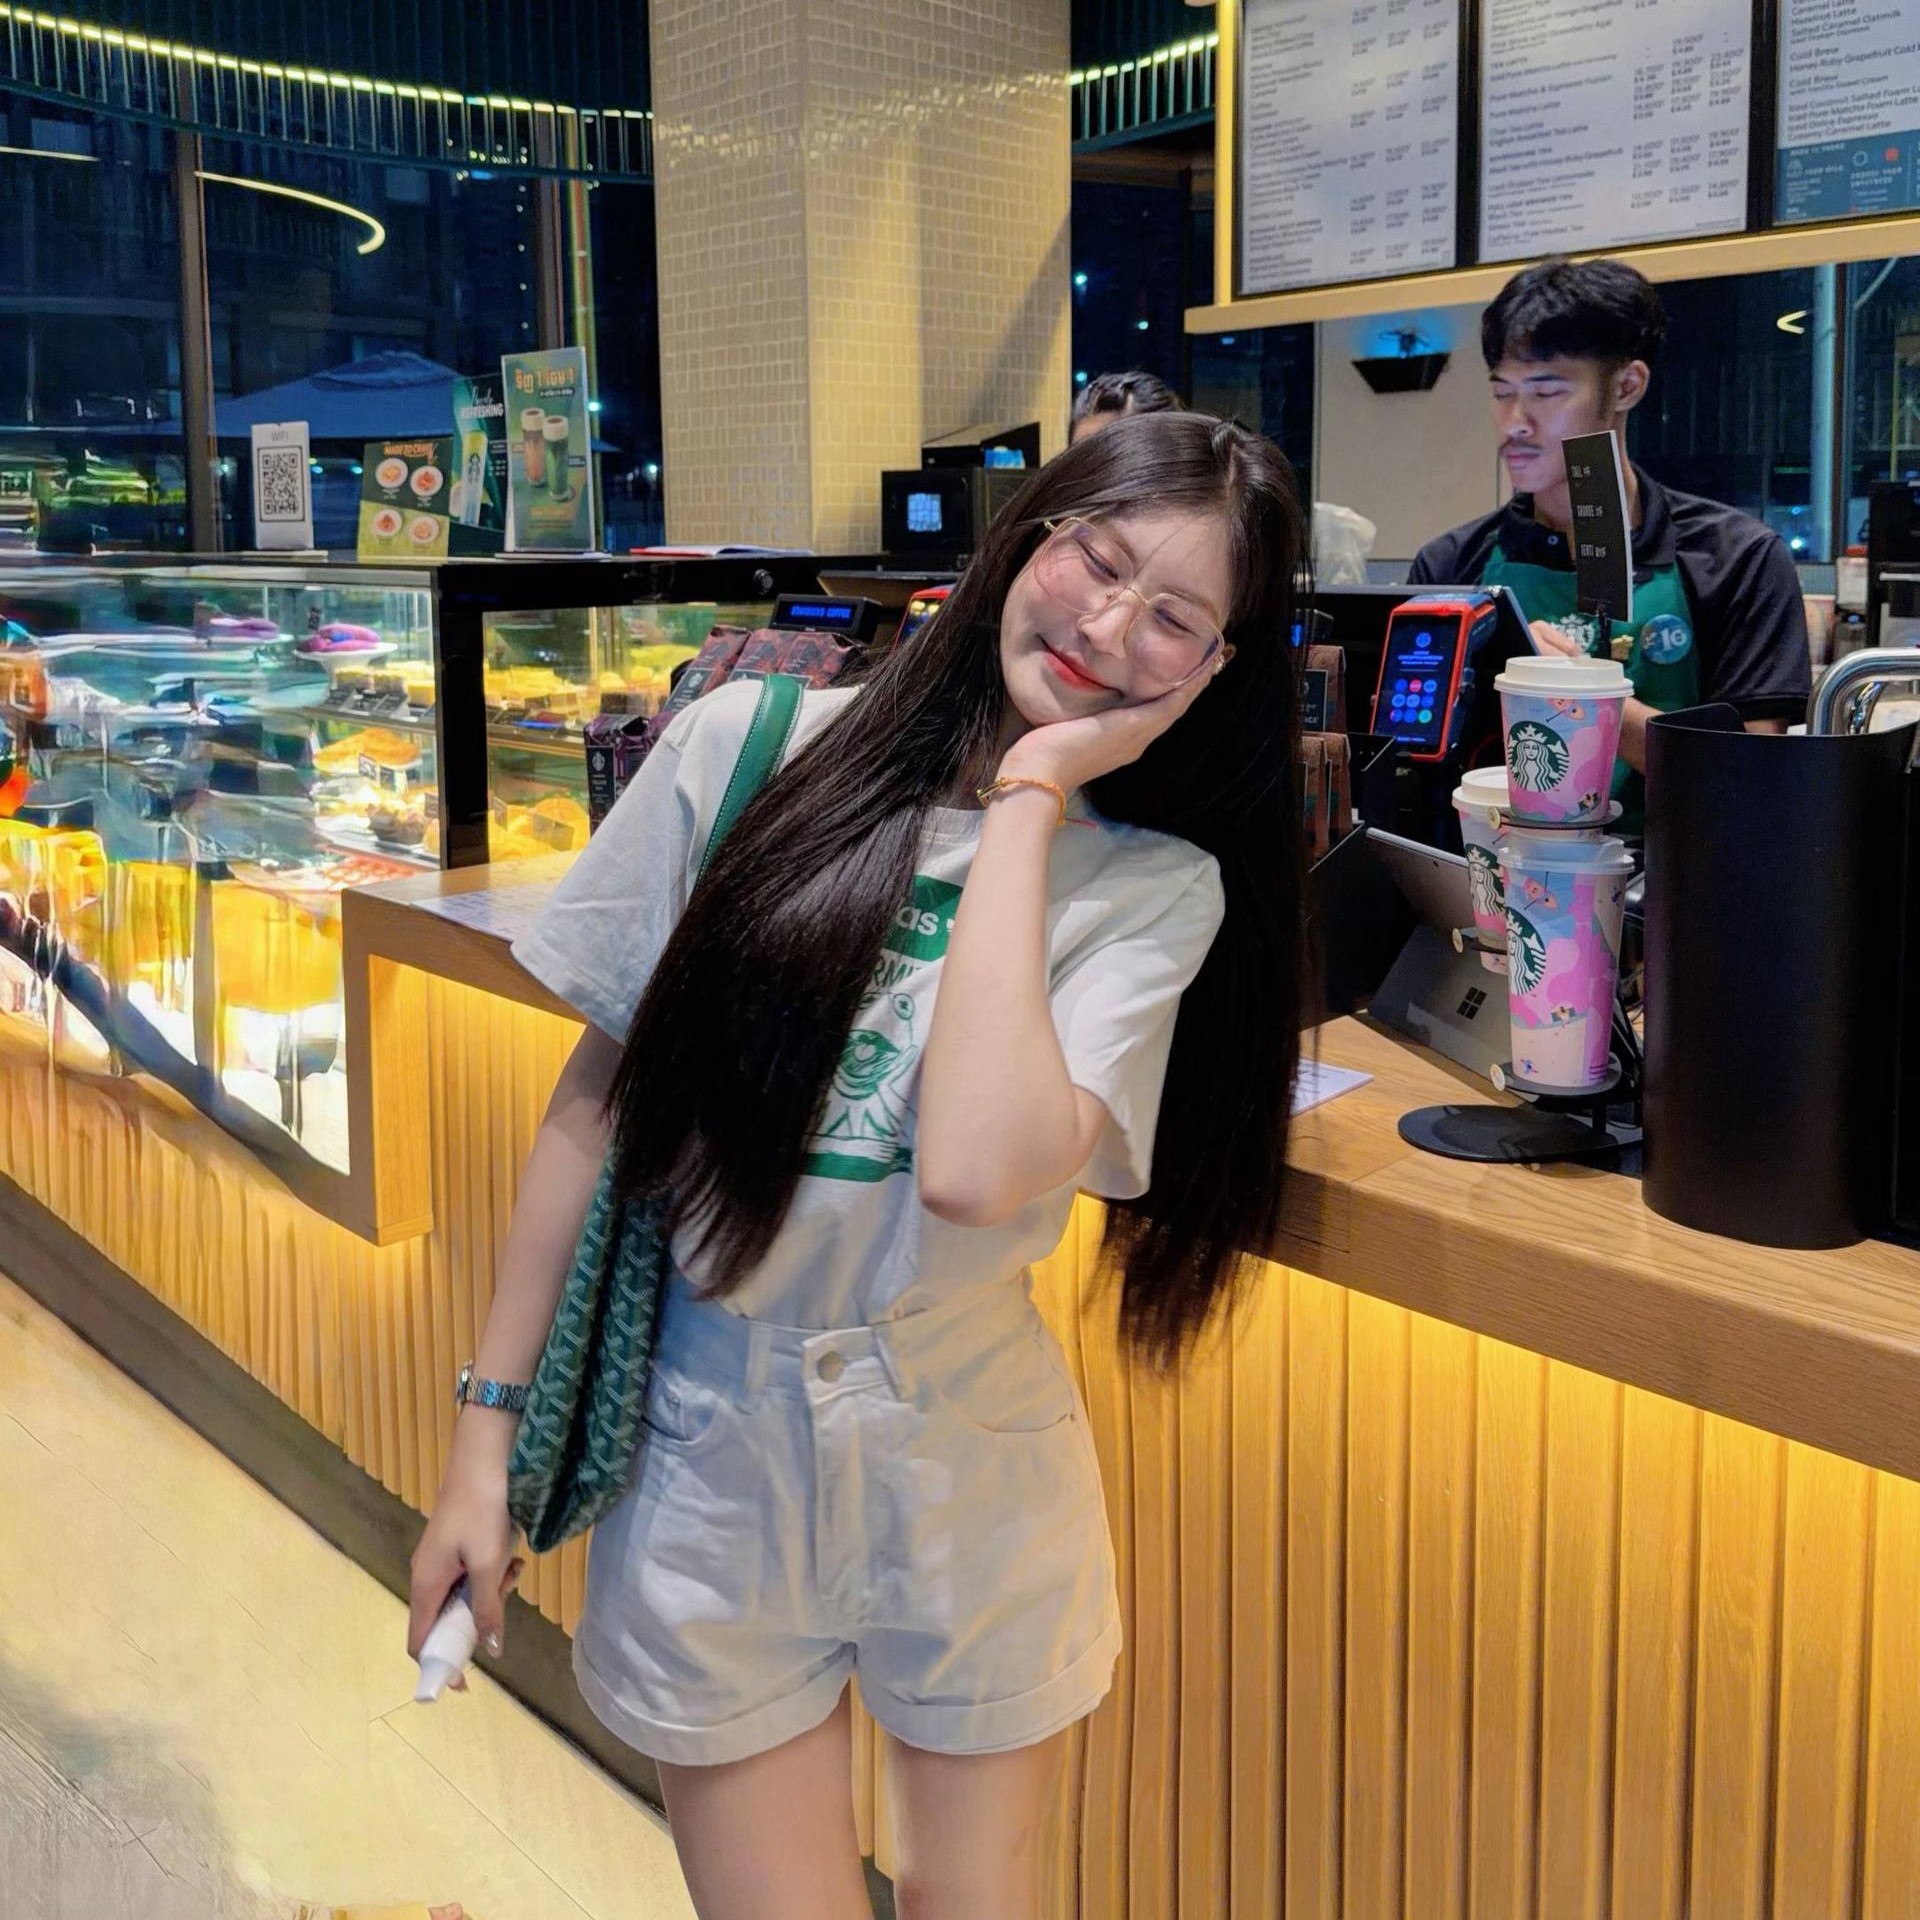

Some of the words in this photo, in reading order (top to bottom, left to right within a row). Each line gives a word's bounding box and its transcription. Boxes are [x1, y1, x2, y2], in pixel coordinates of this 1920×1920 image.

[1791, 12, 1831, 26] Hazelnut
[1833, 8, 1857, 19] Latte
[1792, 25, 1820, 37] Salted
[1822, 18, 1861, 31] Caramel
[1863, 9, 1902, 24] Oatmilk
[1790, 49, 1813, 62] Cold
[1814, 46, 1839, 57] Brew
[1819, 57, 1843, 68] Ruby
[1844, 49, 1893, 64] Grapefruit
[1894, 43, 1917, 56] Cold
[1789, 77, 1812, 89] Cold
[1894, 95, 1919, 107] Latte
[1571, 465, 1584, 478] TALL
[1576, 504, 1595, 518] GRANDE
[1580, 543, 1595, 557] VENTI
[1658, 627, 1688, 651] 10
